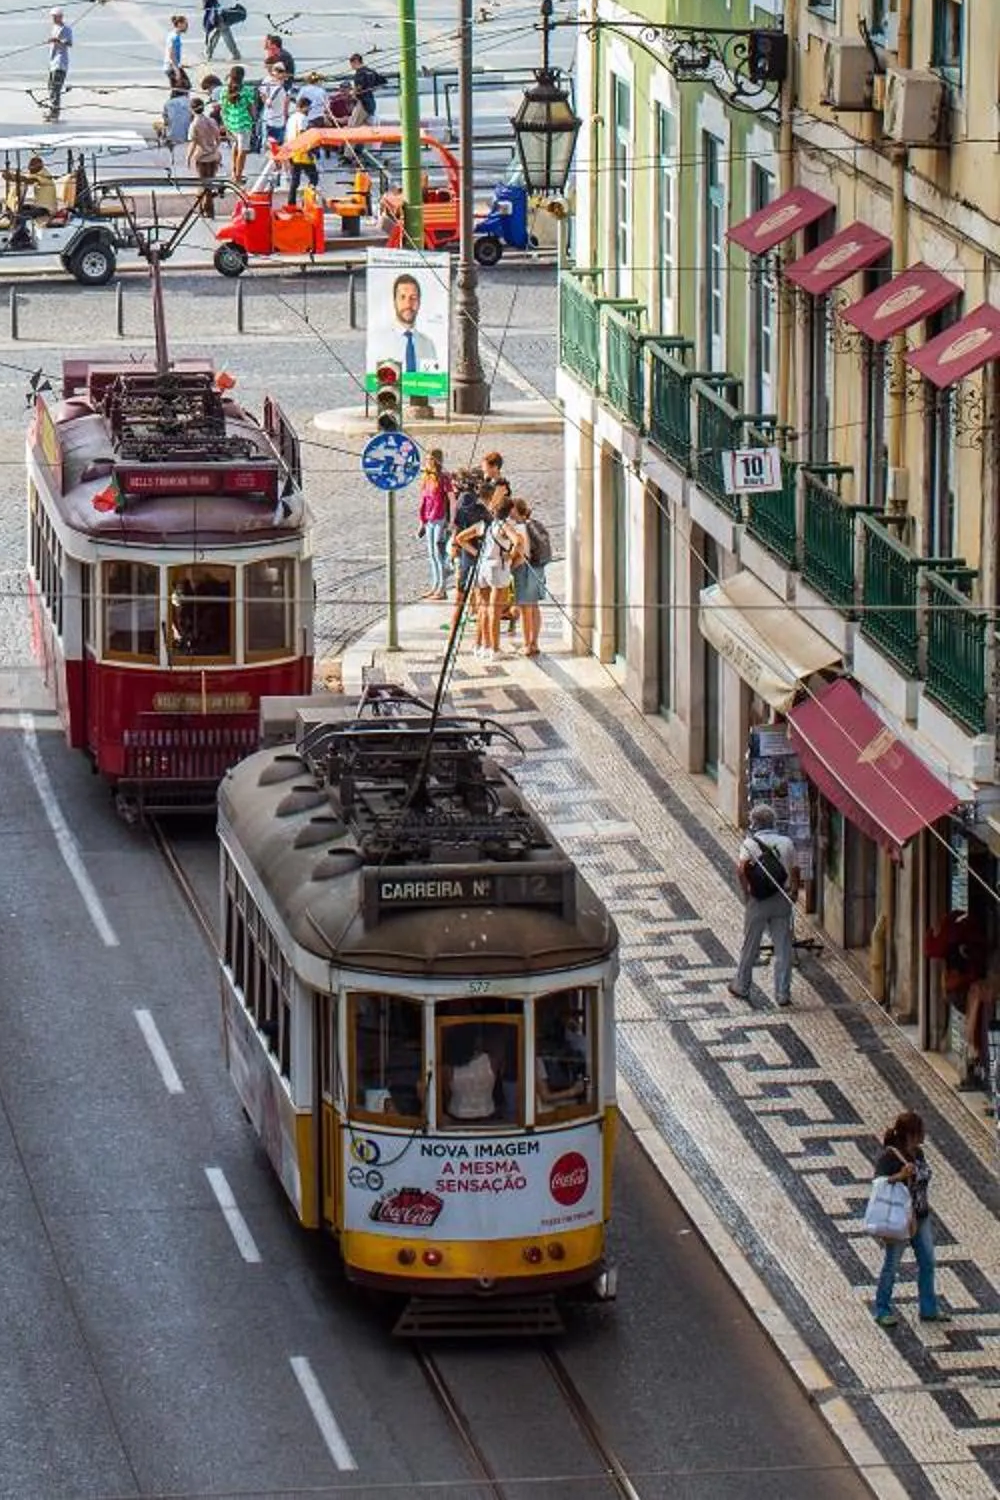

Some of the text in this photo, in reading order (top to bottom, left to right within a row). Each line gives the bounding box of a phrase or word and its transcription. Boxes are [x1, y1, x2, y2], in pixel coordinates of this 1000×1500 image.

[741, 455, 763, 477] 10
[381, 881, 463, 899] CARREIRA
[420, 1140, 540, 1158] NOVA IMAGEM
[441, 1159, 521, 1175] A MESMA
[435, 1174, 528, 1196] SENSAÇÃO
